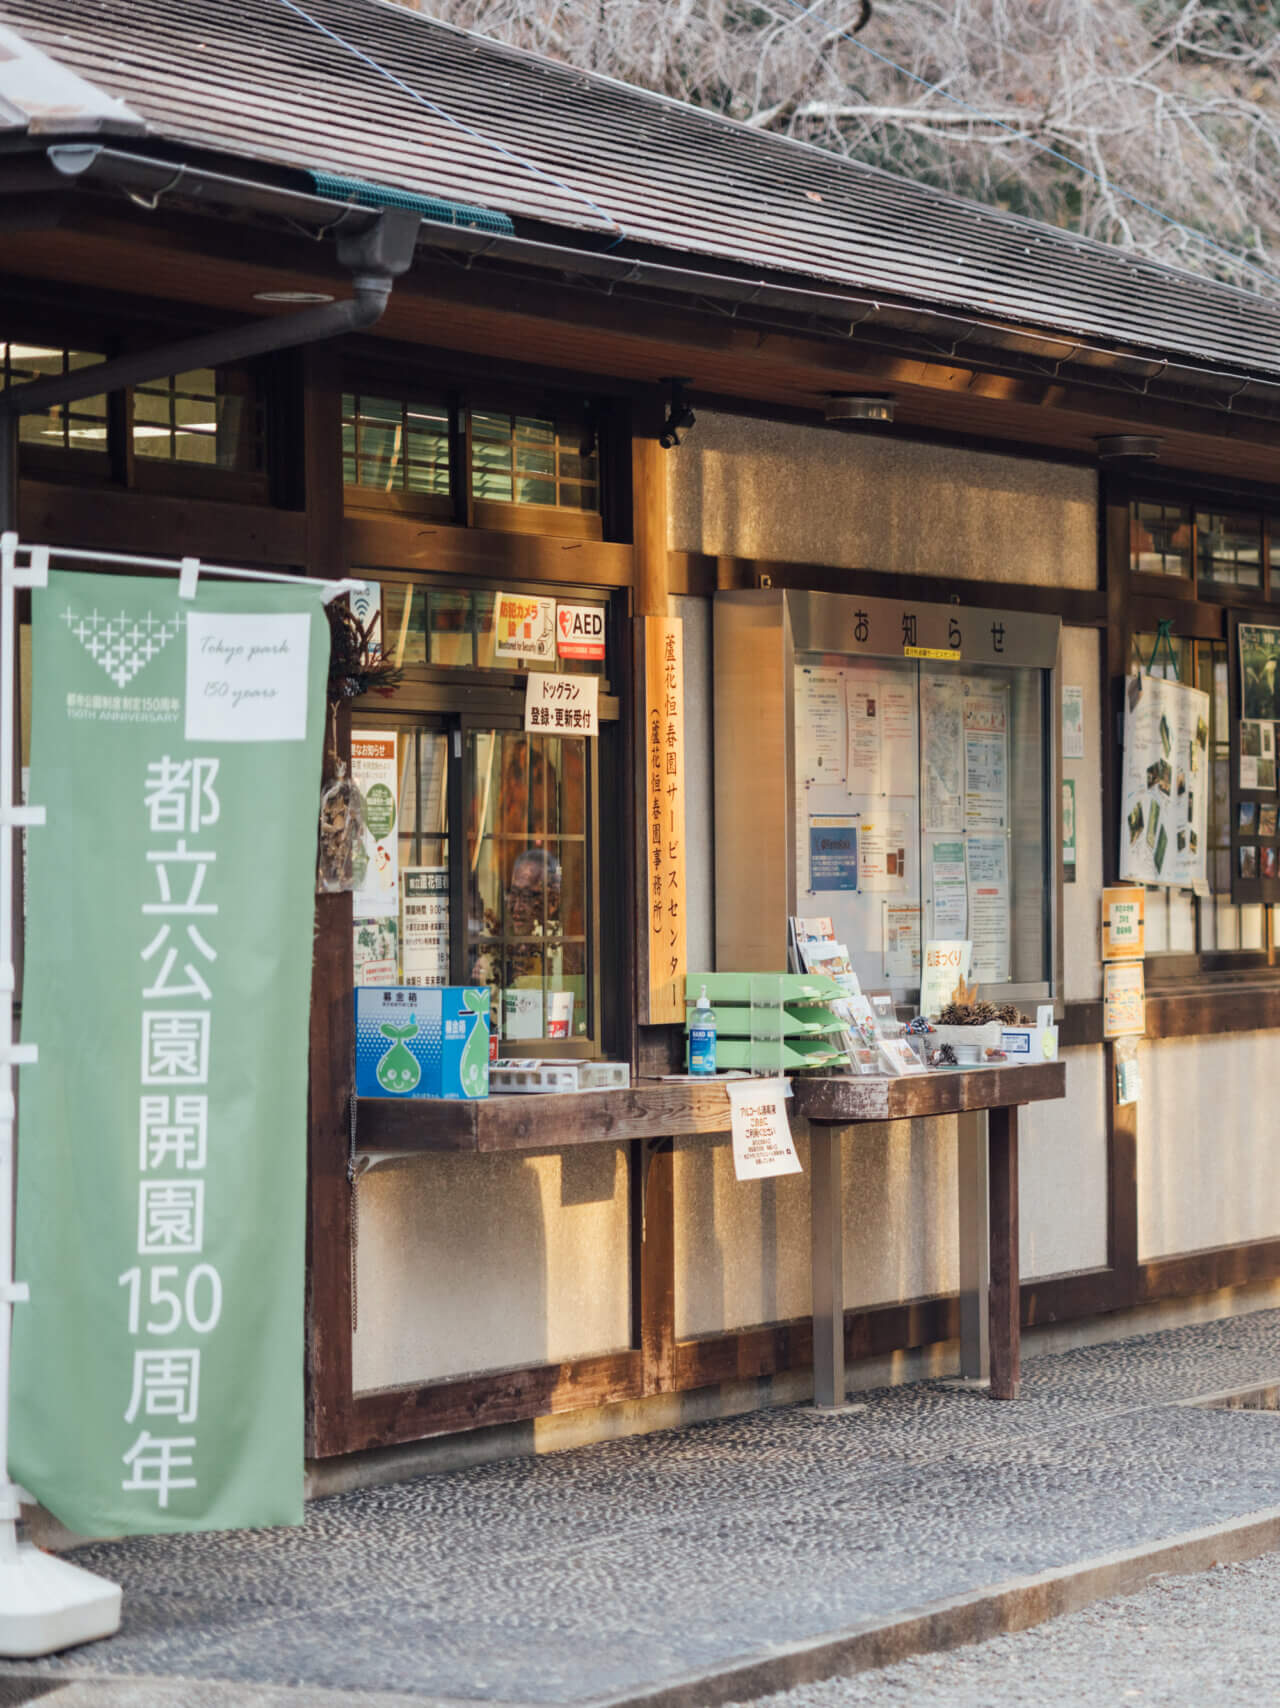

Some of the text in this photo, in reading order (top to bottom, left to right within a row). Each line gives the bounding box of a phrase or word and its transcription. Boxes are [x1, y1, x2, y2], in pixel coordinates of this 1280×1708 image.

[500, 601, 539, 620] 防犯カメラ
[573, 612, 602, 635] AED
[853, 608, 1006, 653] お知らせ
[200, 635, 291, 664] Tokyo park
[203, 680, 278, 709] 150 years
[542, 681, 580, 700] ドッグラン
[99, 711, 180, 722] ANNIVERSARY
[531, 706, 591, 729] 登録・更新受付
[118, 755, 223, 1508] 都立公園開園150周年
